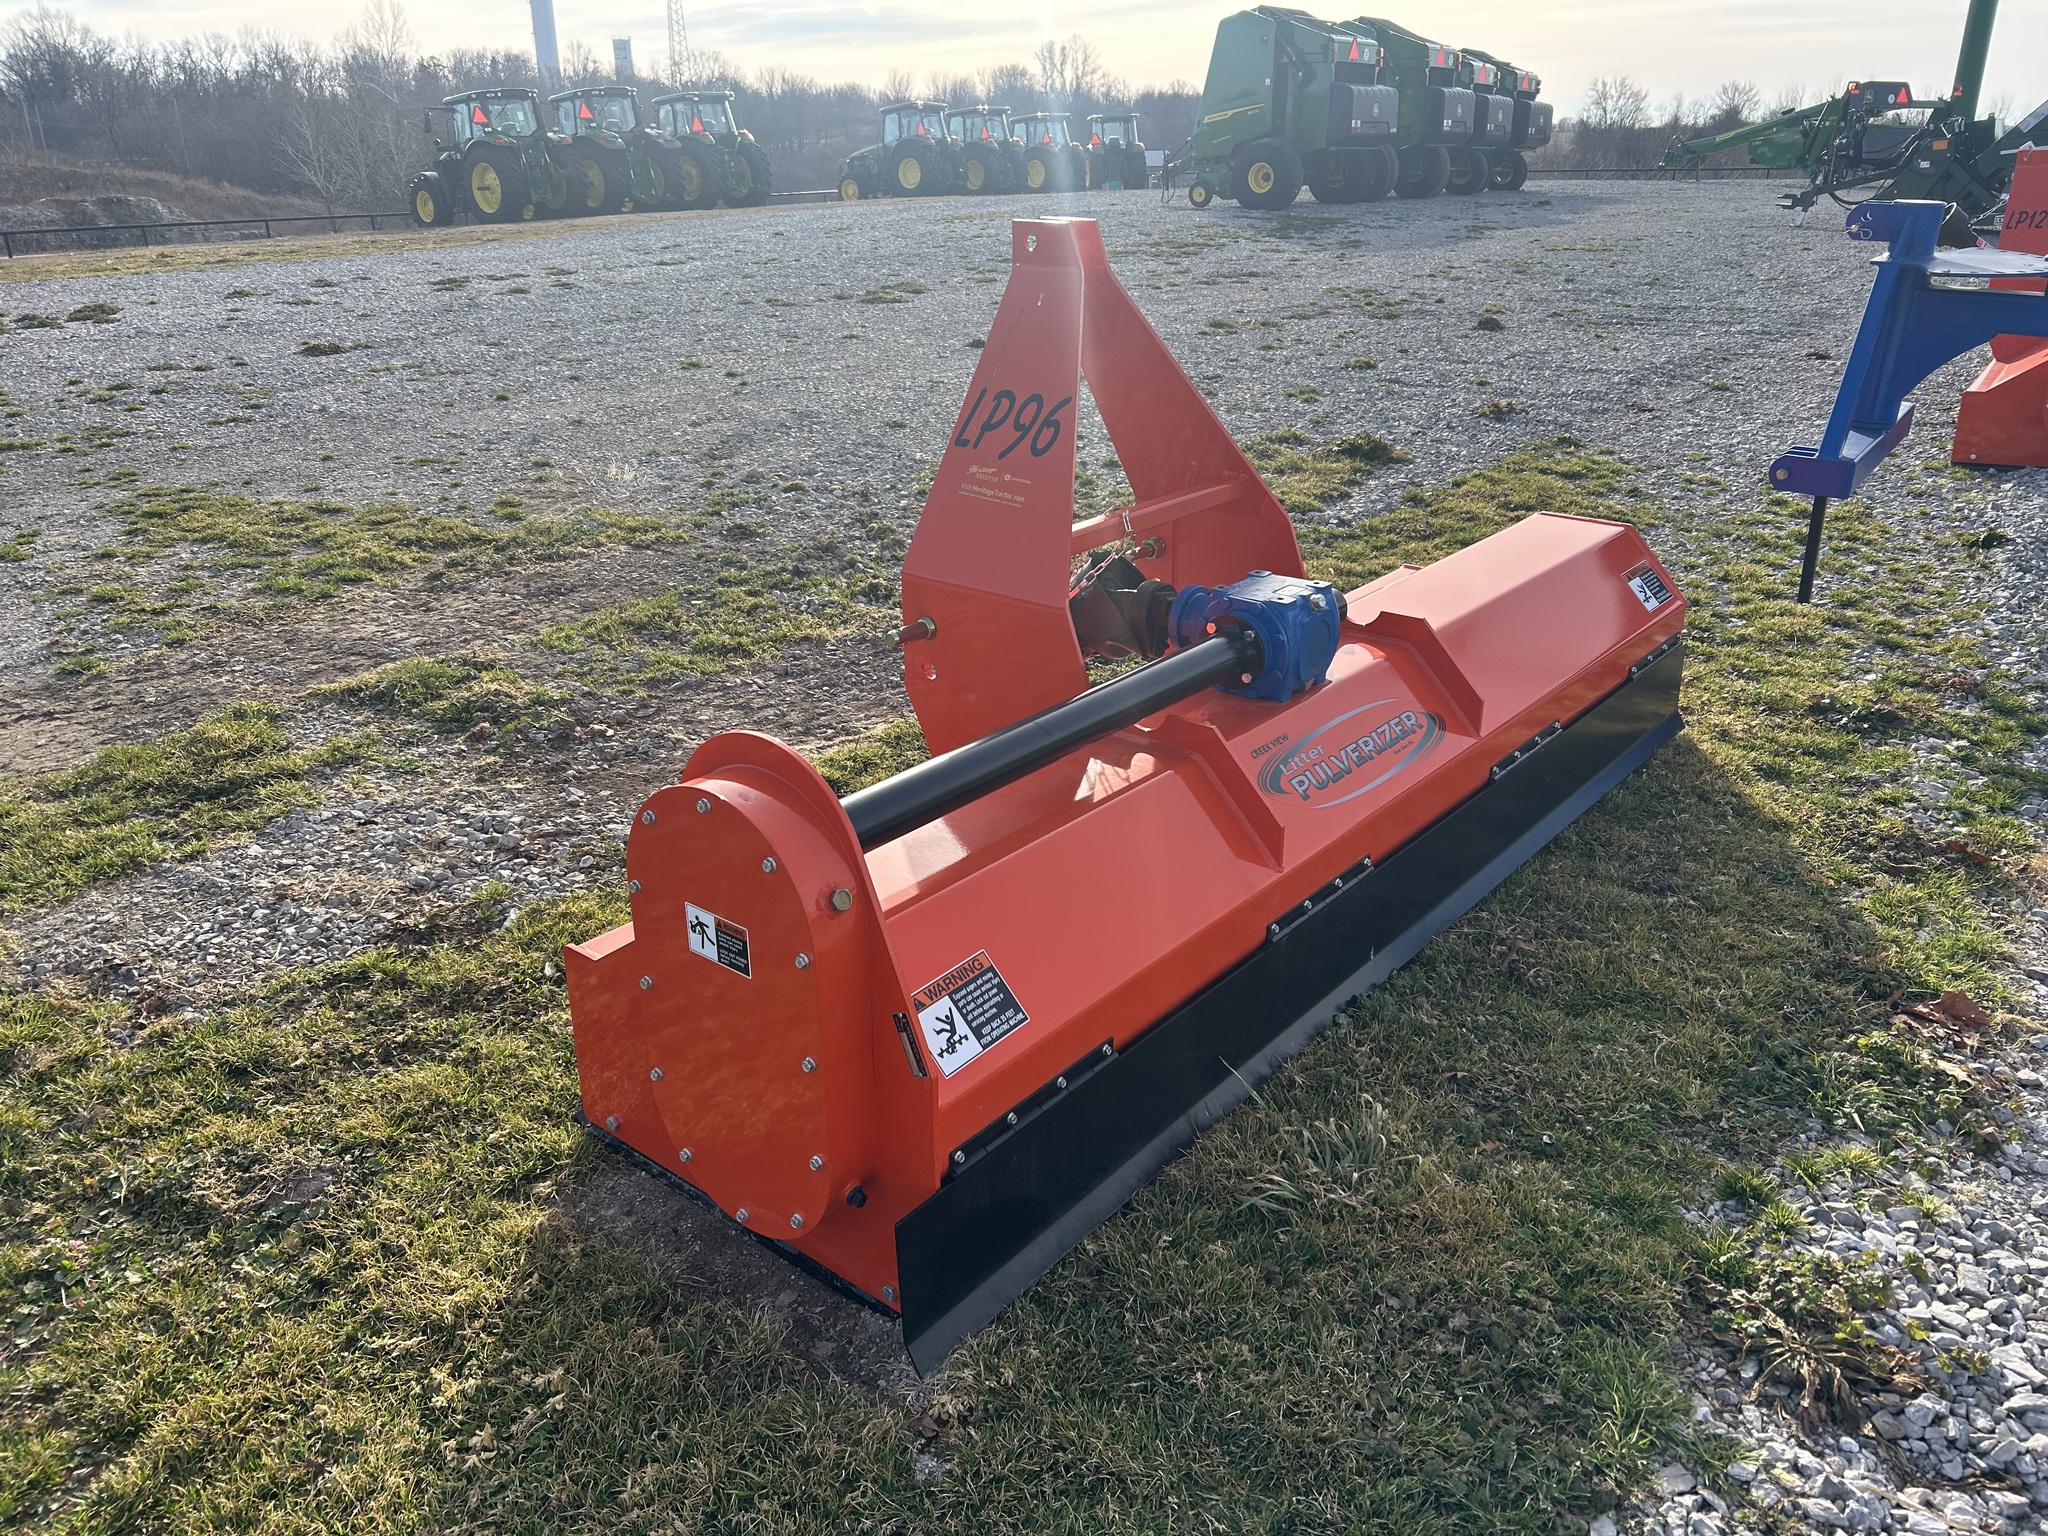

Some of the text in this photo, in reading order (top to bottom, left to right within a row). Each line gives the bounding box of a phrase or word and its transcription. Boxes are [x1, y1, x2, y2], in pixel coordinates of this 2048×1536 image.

[2005, 210, 2048, 229] LP12
[954, 387, 1073, 460] LP96
[967, 465, 997, 474] Heritage
[961, 482, 973, 491] Visit
[972, 484, 1025, 502] HeritageTractor.com
[1250, 732, 1290, 759] CREEK VIEW
[1288, 710, 1424, 801] PULVERIZER
[1279, 744, 1325, 776] Litter
[923, 958, 985, 1002] WARNING
[953, 988, 967, 1001] Exposed
[966, 982, 977, 992] augers
[982, 972, 994, 981] moving
[957, 999, 967, 1008] parts
[972, 989, 982, 998] cause
[981, 982, 992, 992] serious
[991, 977, 1000, 985] injury
[972, 1007, 983, 1017] before
[983, 995, 1001, 1010] approaching
[975, 997, 984, 1005] Lock
[988, 987, 998, 997] power
[971, 1015, 986, 1028] servicing
[980, 1034, 992, 1046] FROM
[991, 1022, 1011, 1039] OPERATING
[981, 1024, 992, 1035] KEEP
[991, 1018, 1002, 1029] BACK
[1005, 1008, 1015, 1019] FEET
